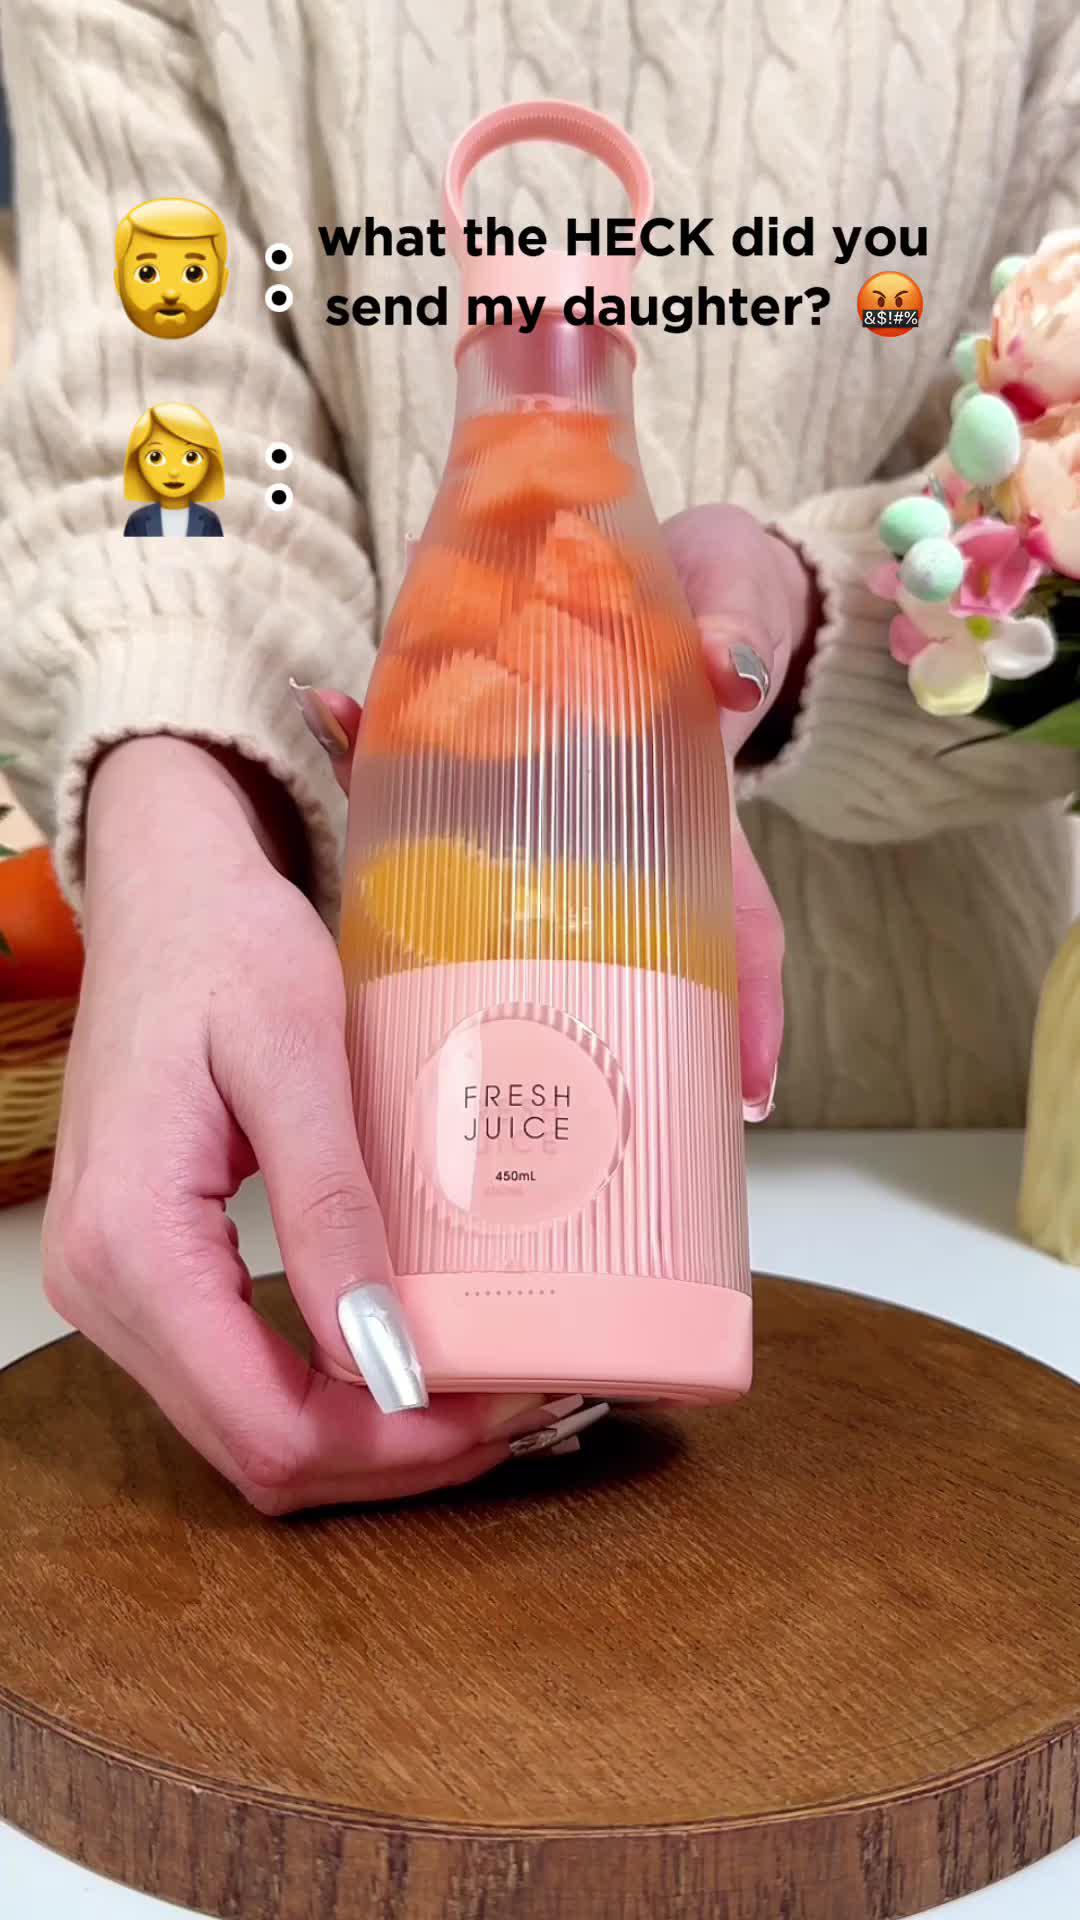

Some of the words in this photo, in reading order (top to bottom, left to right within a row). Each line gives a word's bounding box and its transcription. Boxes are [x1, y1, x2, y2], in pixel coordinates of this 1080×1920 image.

[464, 1084, 570, 1108] FRESH
[464, 1116, 569, 1141] JUICE
[495, 1170, 536, 1182] 450mL
